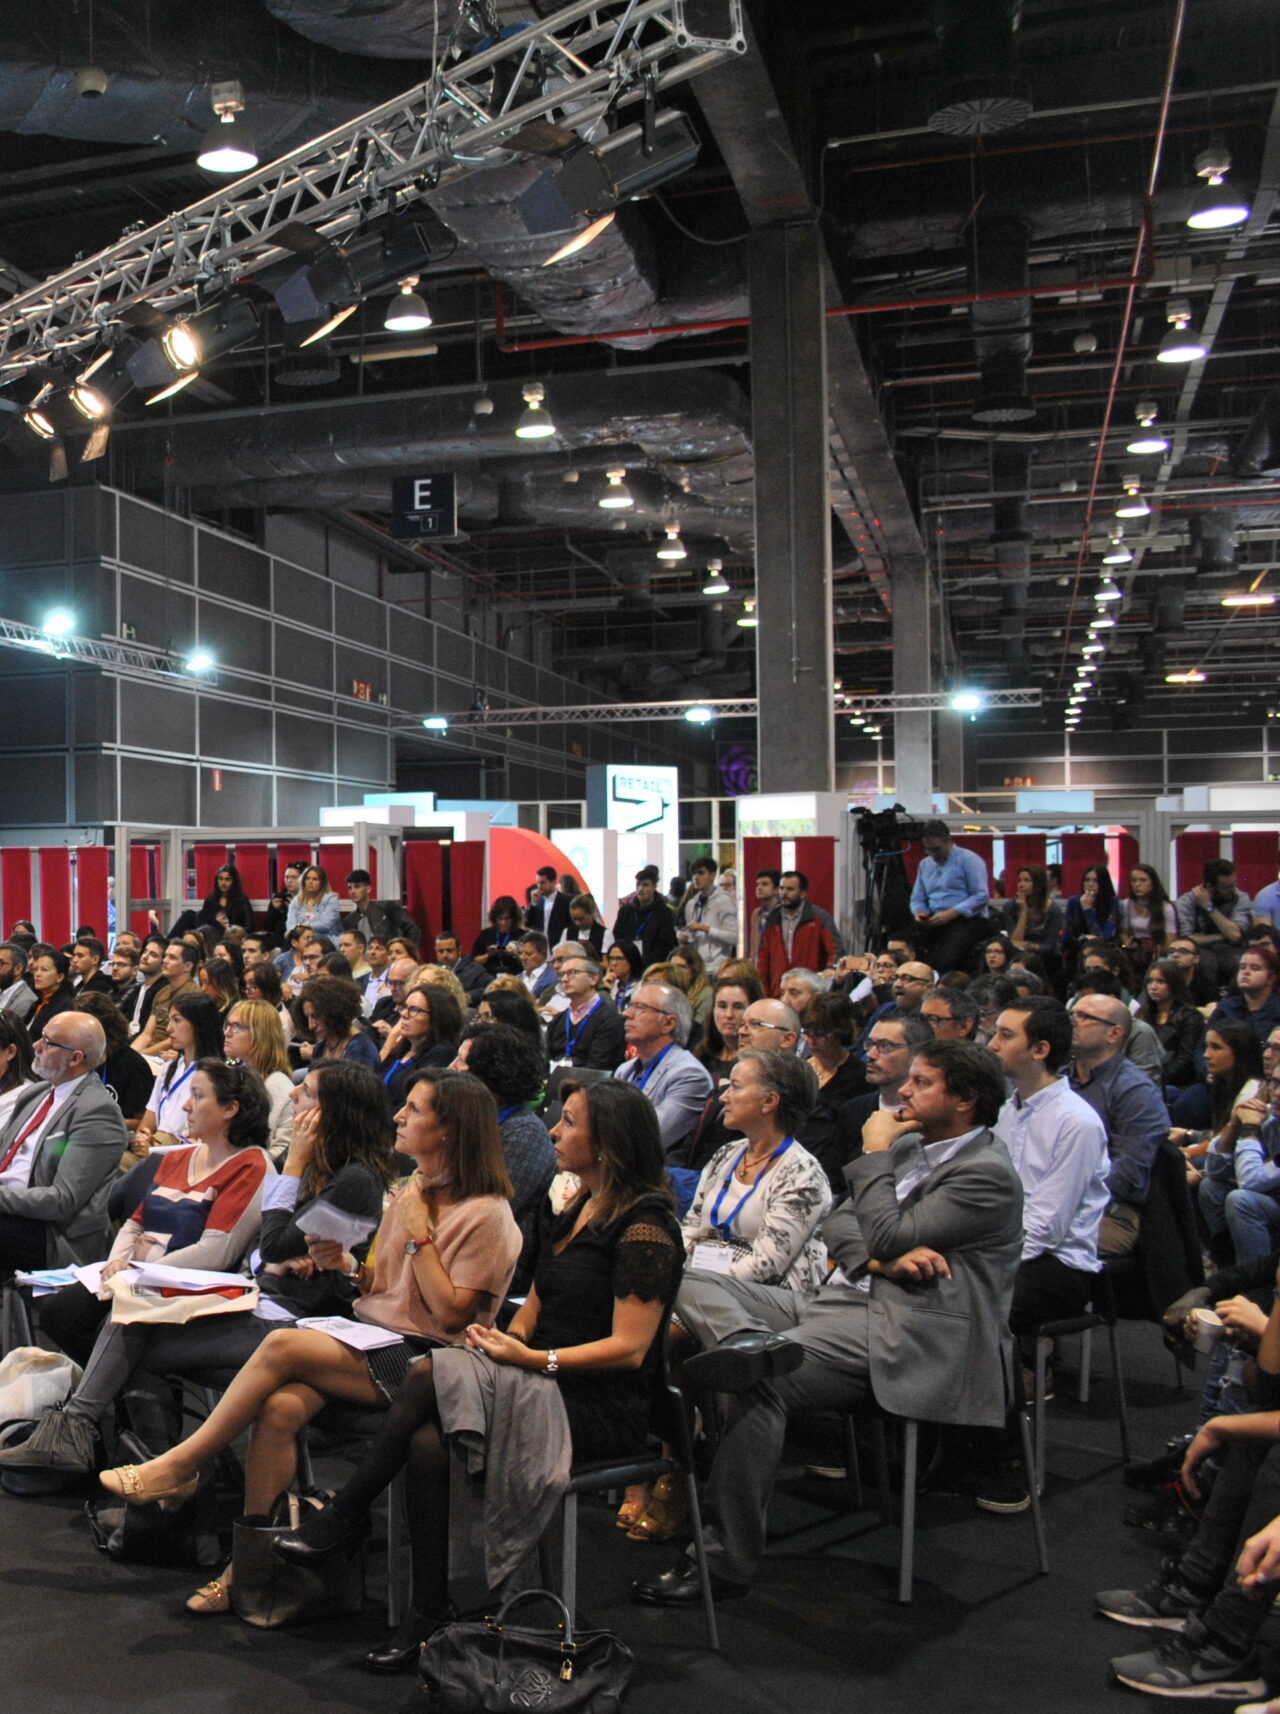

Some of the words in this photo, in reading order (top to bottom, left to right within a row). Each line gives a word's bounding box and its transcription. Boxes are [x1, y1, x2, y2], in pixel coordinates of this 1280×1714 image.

[414, 479, 432, 510] E
[427, 517, 433, 529] 1
[618, 777, 663, 793] RETAIL
